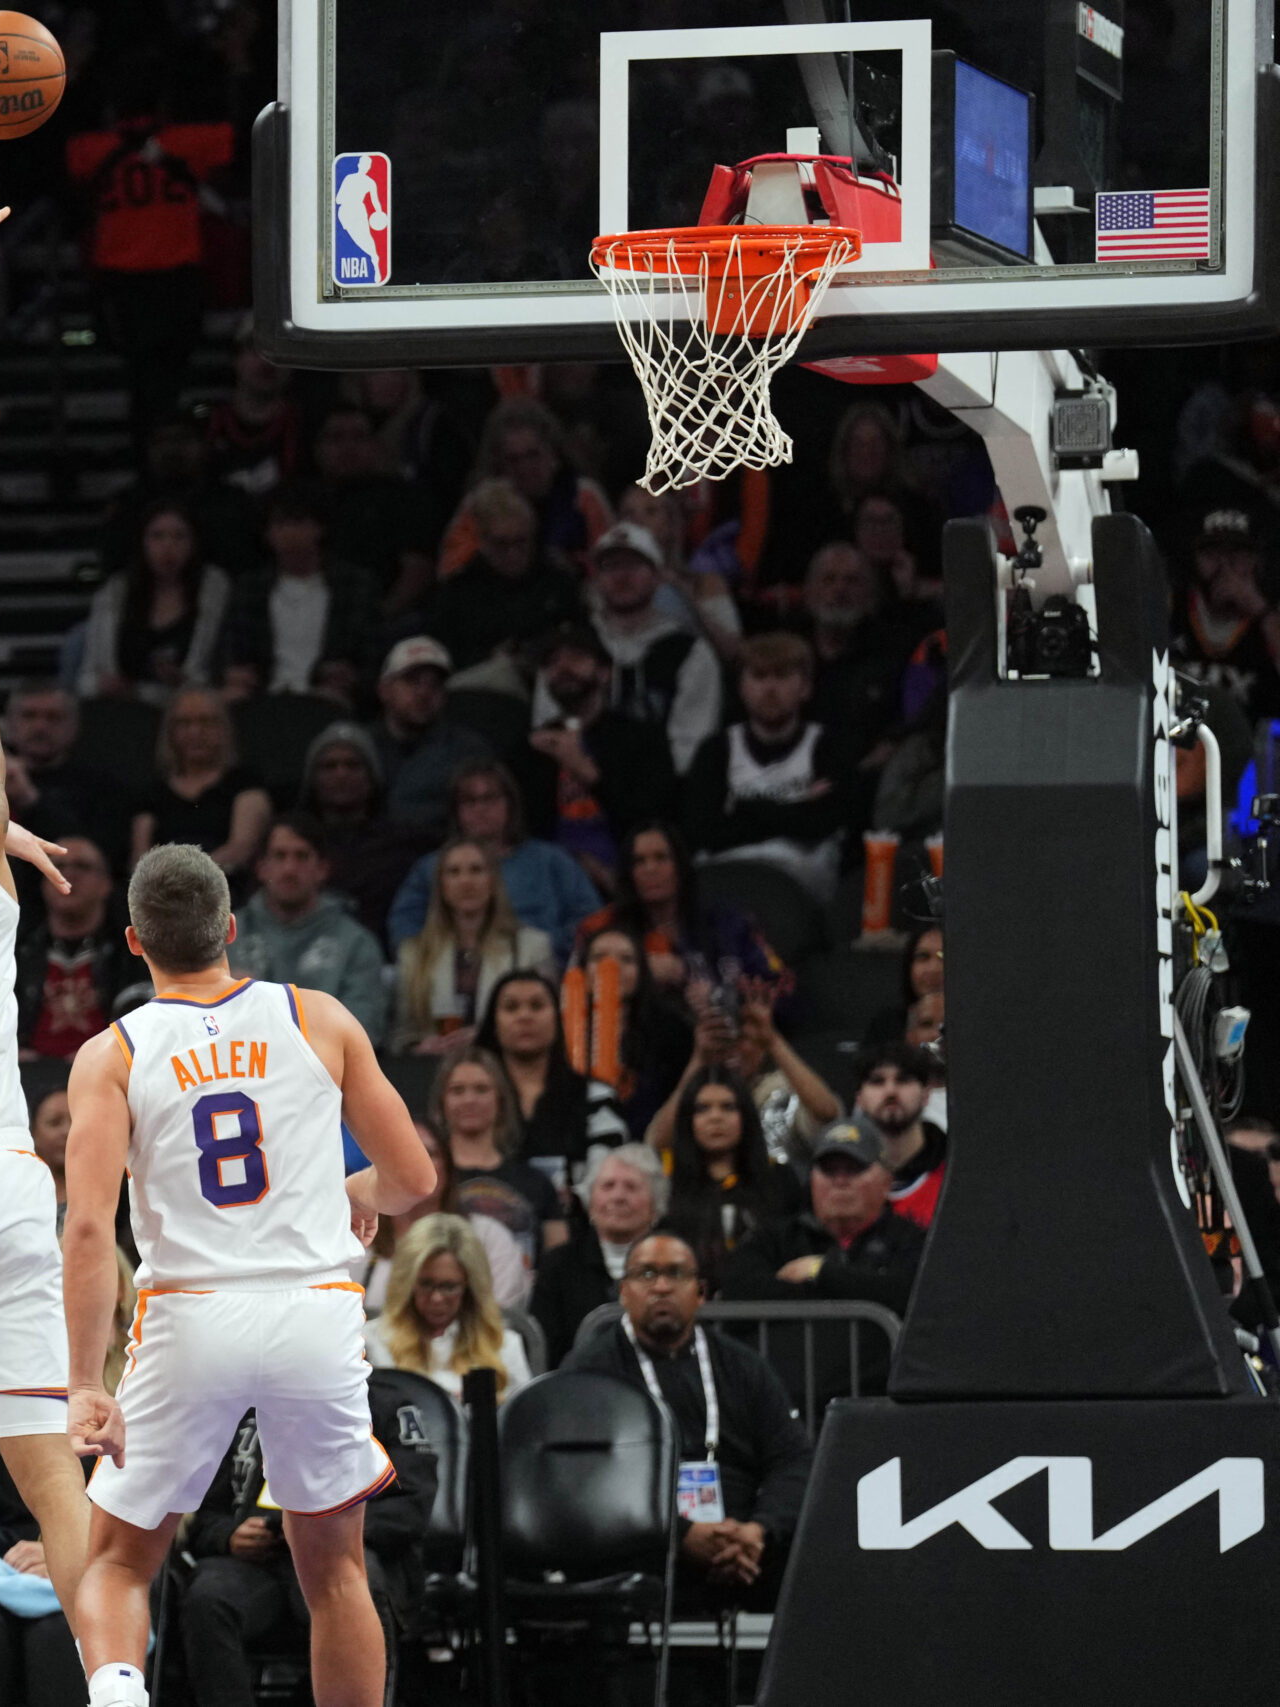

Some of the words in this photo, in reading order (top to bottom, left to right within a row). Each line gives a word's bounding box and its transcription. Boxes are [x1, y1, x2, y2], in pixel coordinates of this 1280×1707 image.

[340, 257, 368, 279] NBA
[170, 1041, 268, 1092] ALLEN
[192, 1091, 270, 1210] 8
[857, 1456, 1265, 1554] KIA
